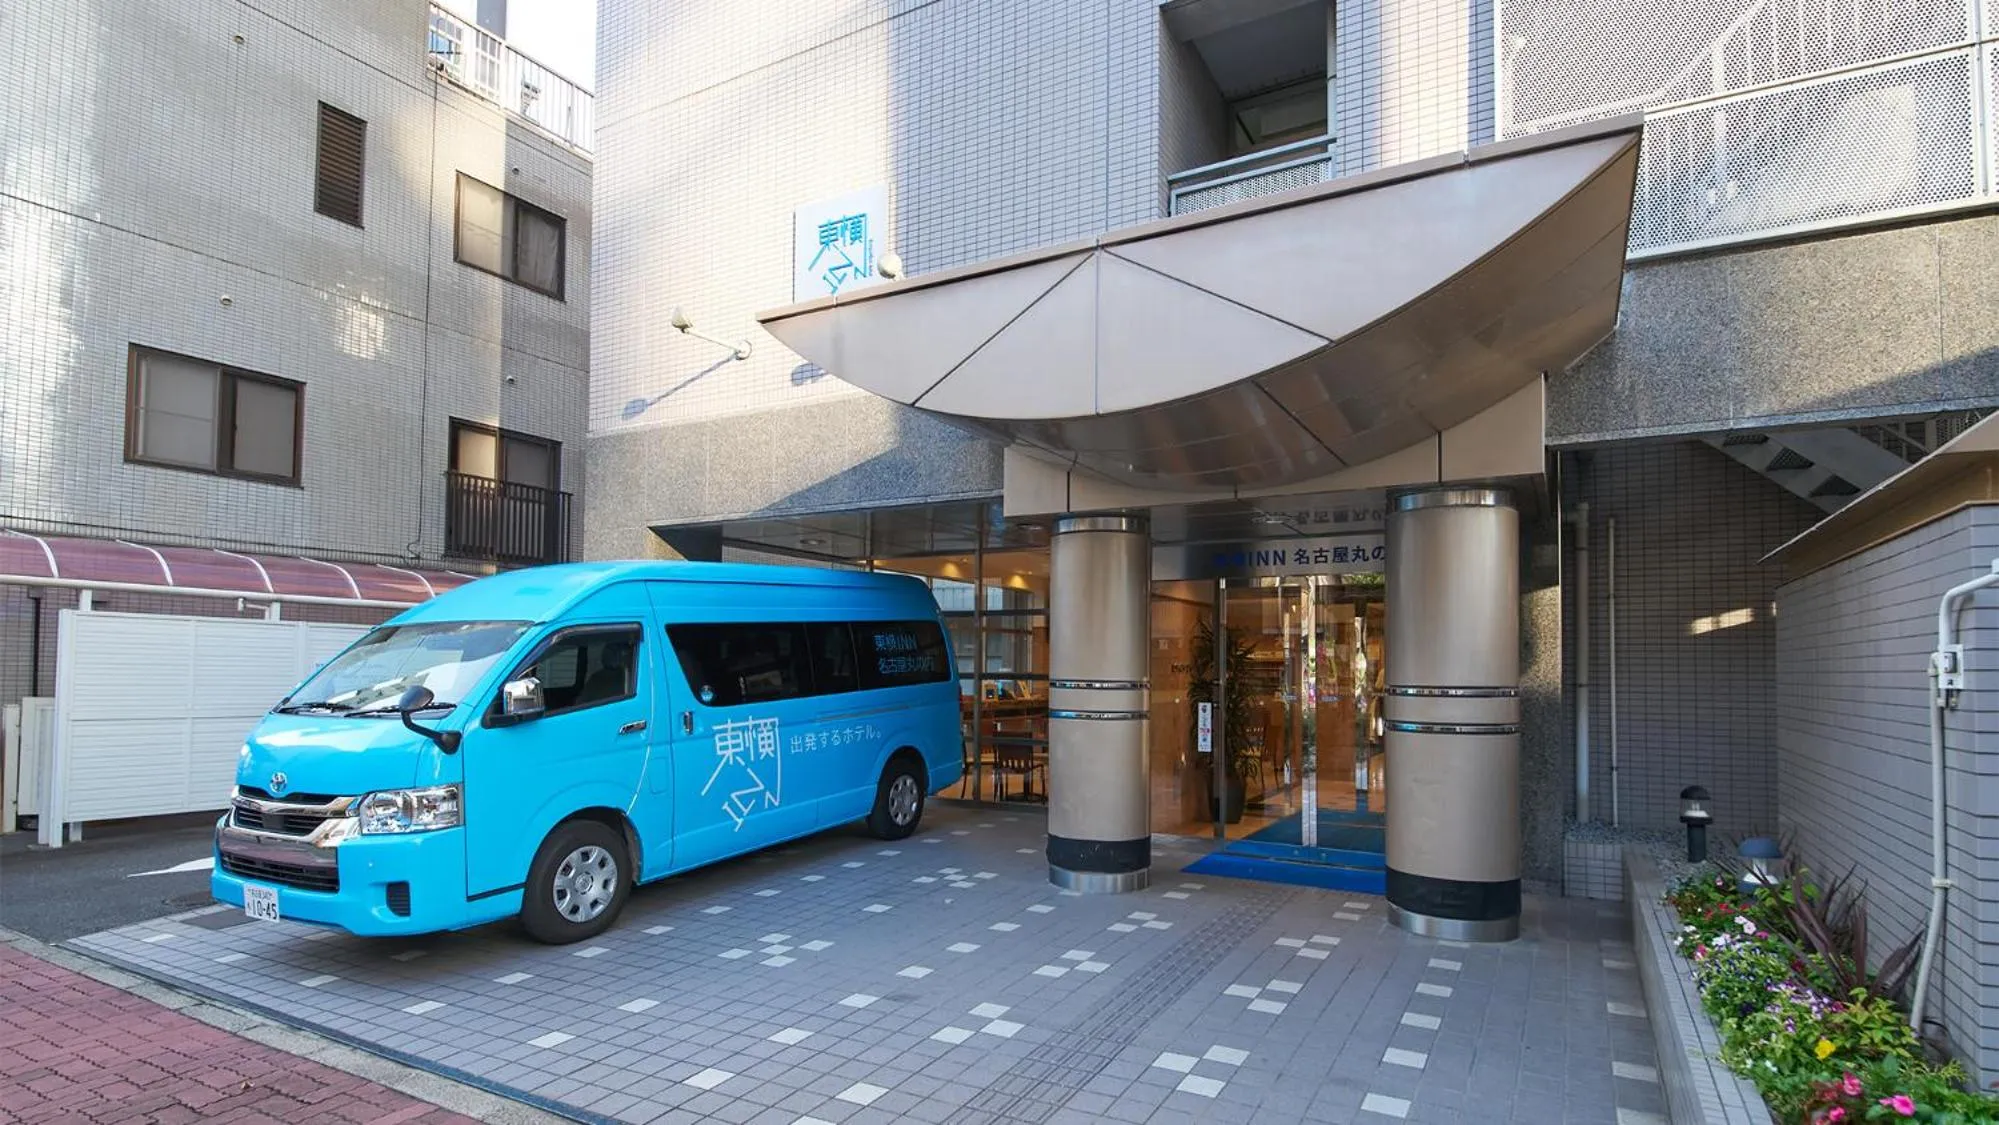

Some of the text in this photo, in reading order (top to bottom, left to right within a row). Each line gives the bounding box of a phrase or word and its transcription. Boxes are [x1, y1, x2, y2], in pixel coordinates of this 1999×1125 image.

[1294, 545, 1386, 565] 名古屋丸の
[791, 725, 881, 753] 出発するホテル。
[252, 900, 277, 920] 10-45
